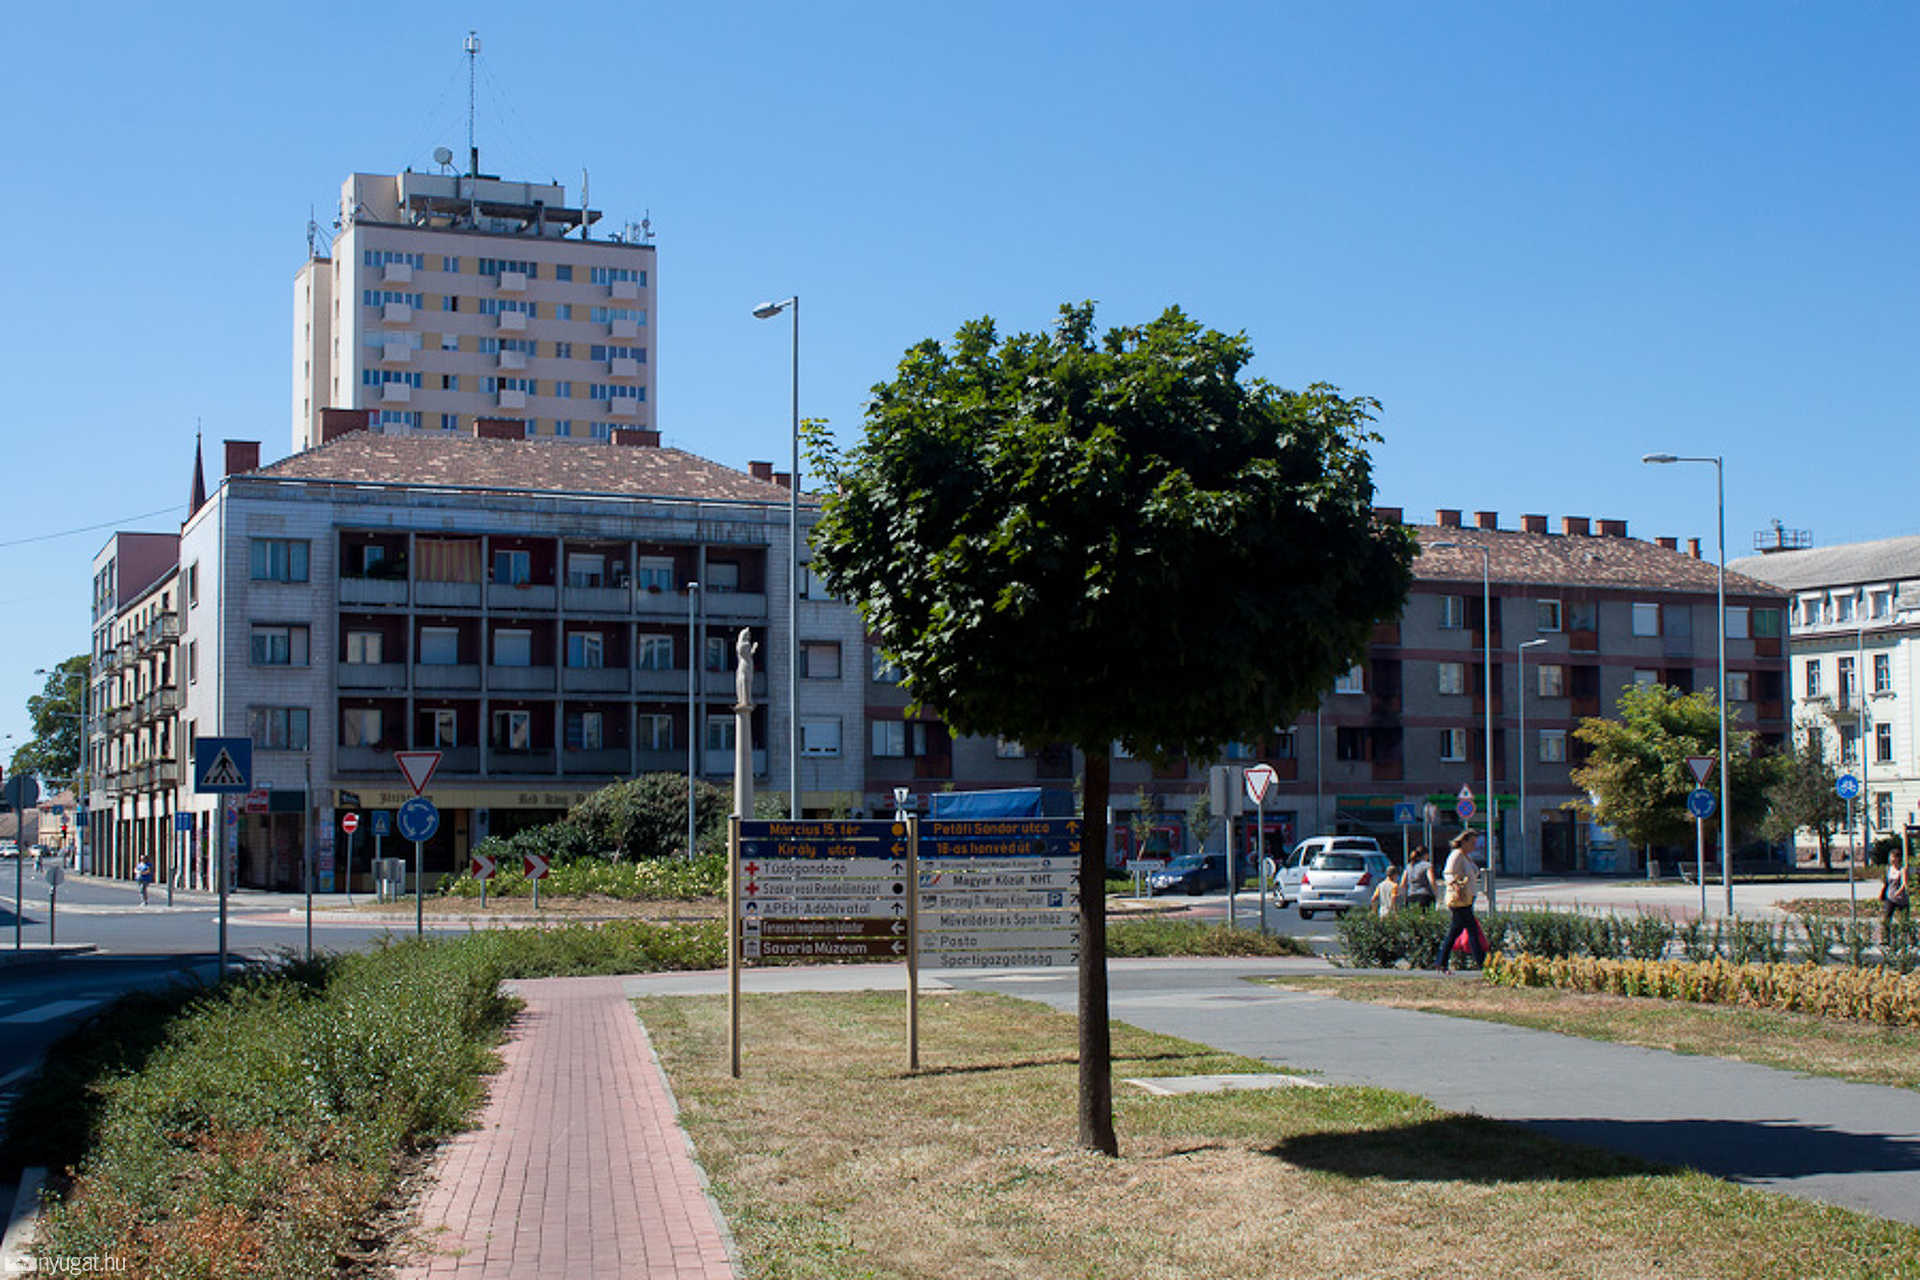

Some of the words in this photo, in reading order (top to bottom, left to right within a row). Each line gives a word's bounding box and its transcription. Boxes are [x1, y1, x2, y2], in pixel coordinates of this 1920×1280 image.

[769, 823, 820, 835] Március
[840, 823, 861, 835] tér
[934, 822, 972, 835] Petőfi
[974, 822, 1018, 835] Sándor
[1021, 823, 1050, 834] utca
[778, 843, 816, 859] Király
[828, 845, 857, 855] utca
[970, 841, 1016, 854] honvéd
[953, 875, 991, 888] Magyar
[763, 943, 810, 954] Savaria
[814, 941, 868, 954] Múzeum
[940, 936, 977, 946] Posta
